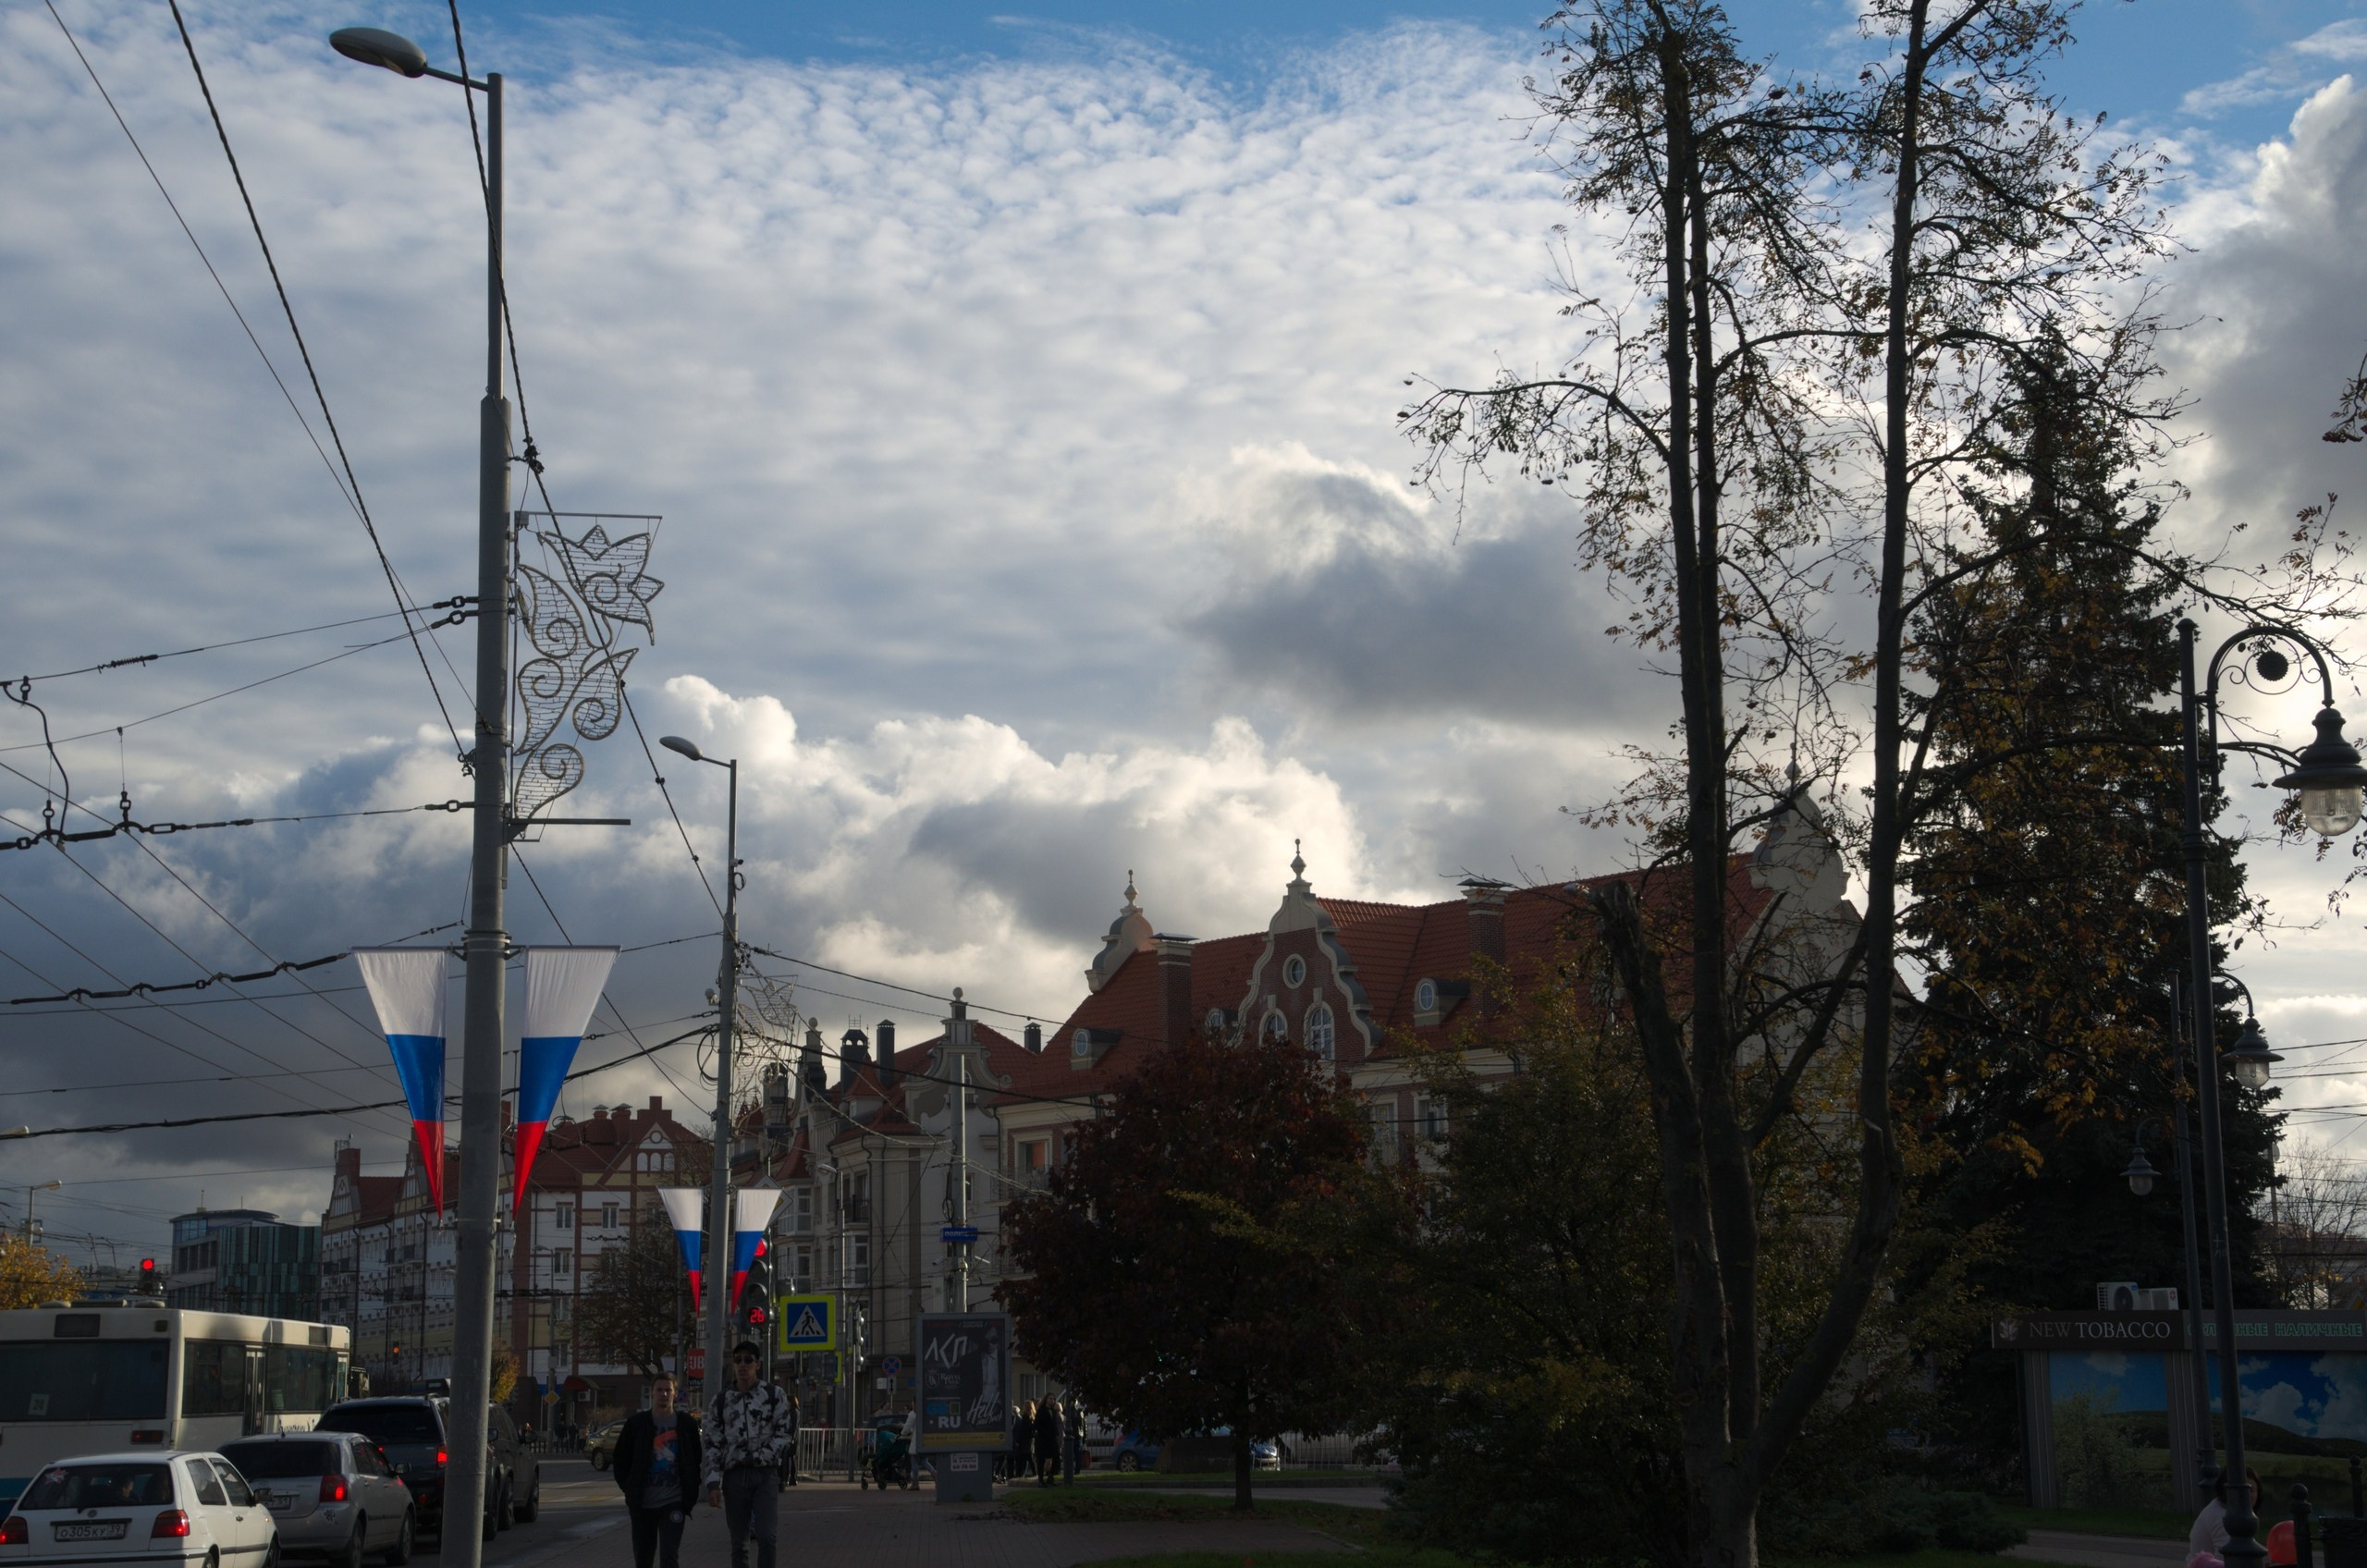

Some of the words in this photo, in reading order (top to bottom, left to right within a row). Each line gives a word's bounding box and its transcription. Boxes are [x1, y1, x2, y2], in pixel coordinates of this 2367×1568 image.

[2029, 1322, 2071, 1338] NEW
[2075, 1321, 2171, 1339] TOBACCO
[2275, 1322, 2362, 1337] НАЛИЧНЫЕ
